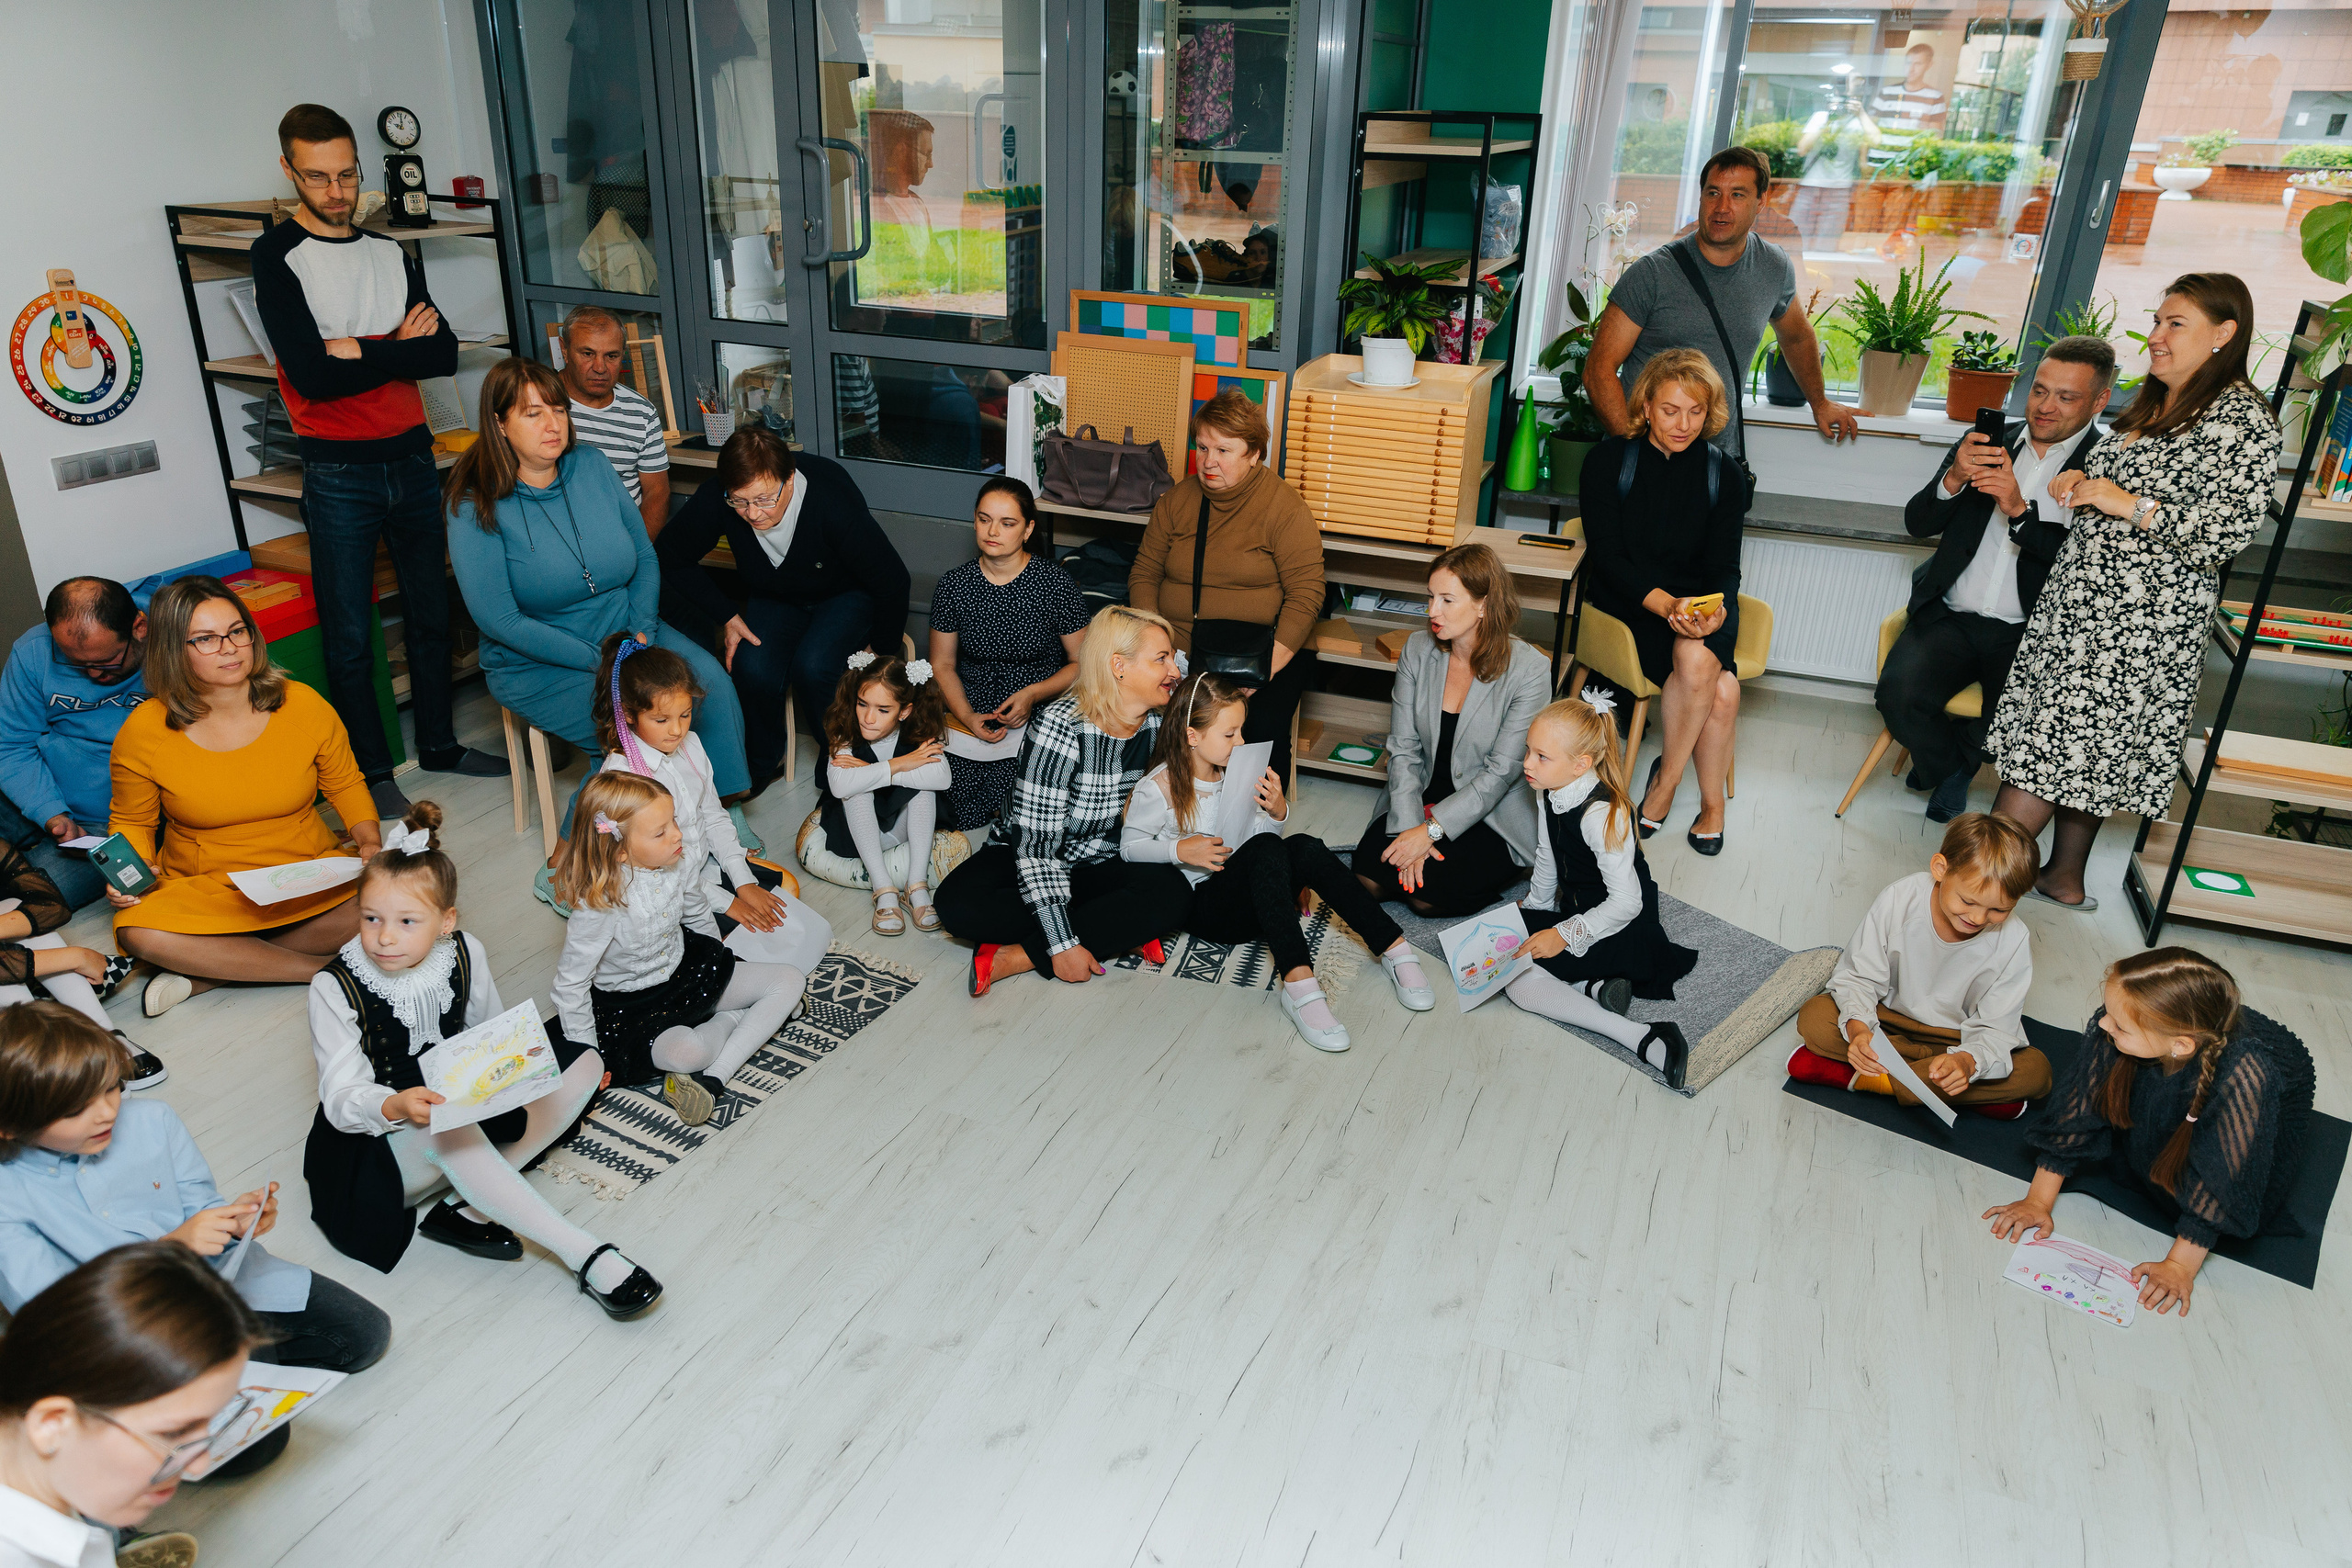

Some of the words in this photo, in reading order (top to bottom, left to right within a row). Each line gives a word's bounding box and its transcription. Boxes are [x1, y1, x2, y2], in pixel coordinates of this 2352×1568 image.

[38, 298, 50, 308] 30
[27, 306, 37, 317] 29
[18, 318, 28, 330] 28
[14, 332, 22, 344] 27
[132, 343, 139, 351] 10
[14, 348, 21, 360] 26
[16, 364, 24, 376] 25
[23, 379, 32, 390] 24
[133, 375, 140, 383] 13
[31, 392, 43, 404] 23
[44, 403, 56, 413] 22
[108, 409, 116, 417] 17
